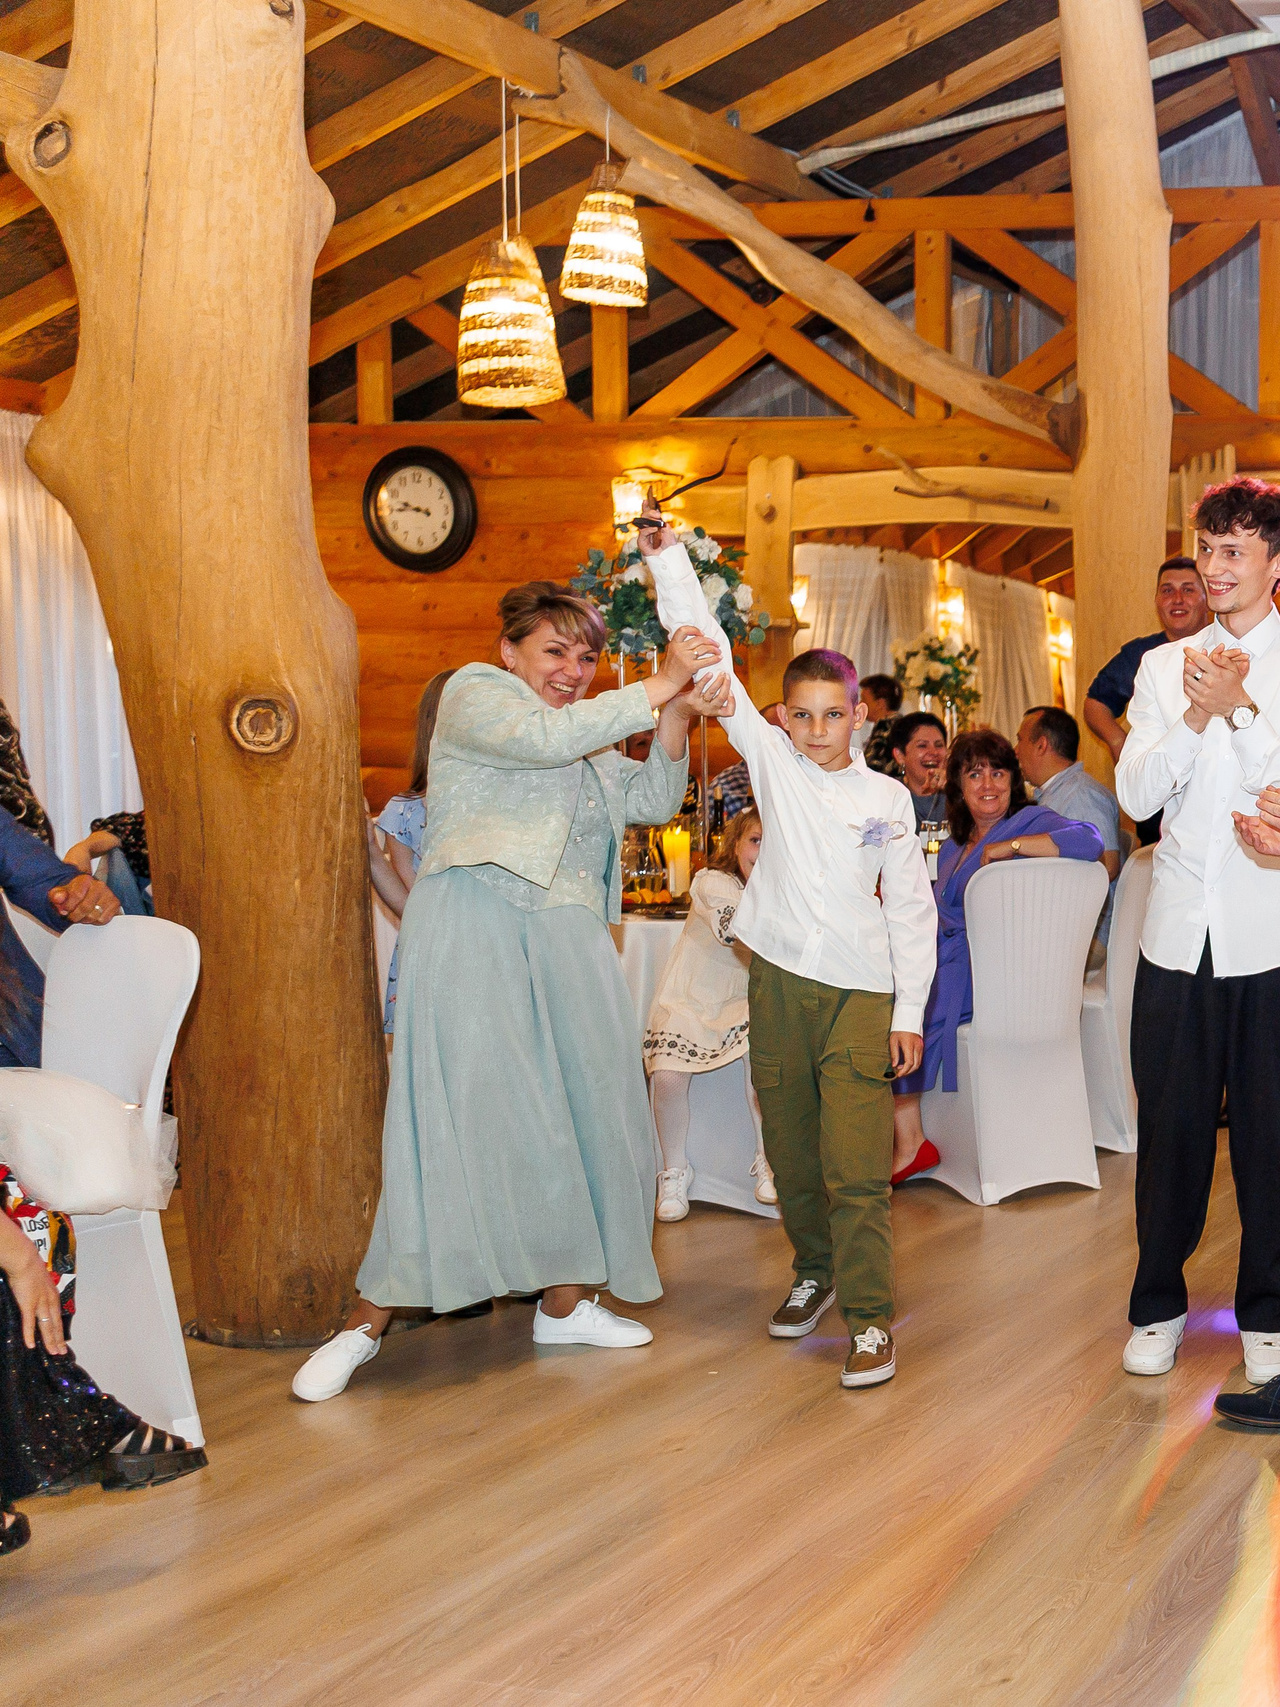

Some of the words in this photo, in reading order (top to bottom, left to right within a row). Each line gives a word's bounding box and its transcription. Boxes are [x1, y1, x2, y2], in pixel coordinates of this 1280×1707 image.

[399, 475, 408, 488] 11
[411, 471, 422, 484] 12
[438, 487, 445, 500] 2
[441, 520, 448, 531] 4
[403, 530, 409, 542] 7
[416, 535, 424, 547] 6
[432, 531, 439, 543] 5
